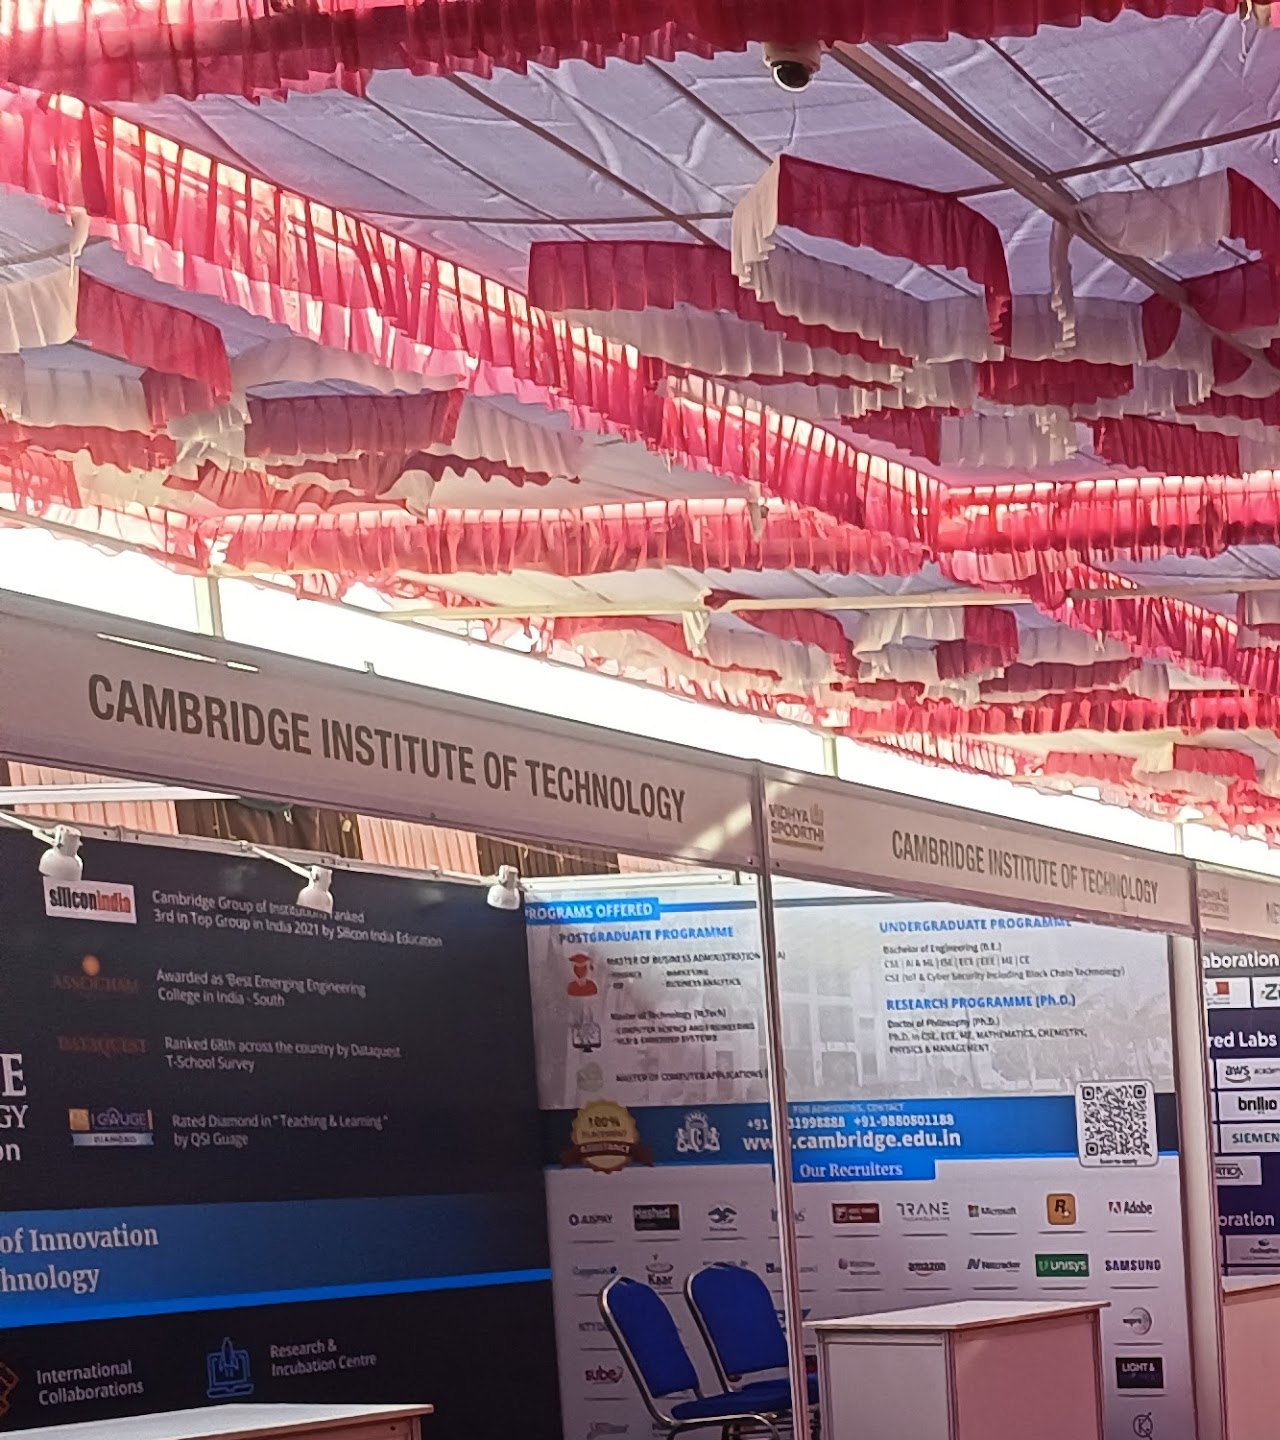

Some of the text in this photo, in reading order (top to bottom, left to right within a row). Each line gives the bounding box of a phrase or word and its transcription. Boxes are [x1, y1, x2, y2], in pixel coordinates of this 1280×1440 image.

[88, 674, 686, 824] CAMBRIDGE INSTITUTE OF TECHNOLOGY
[768, 803, 809, 824] VIDHYA
[770, 819, 824, 843] SPOORTHI
[891, 829, 985, 873] CAMBRIDGE
[988, 848, 1058, 888] INSTITUTE
[1061, 862, 1078, 891] OF
[1080, 866, 1159, 905] TECHNOLOGY
[152, 890, 267, 914] Cambridge Group of
[595, 902, 653, 919] OFFERED
[153, 909, 174, 923] 3rd
[177, 911, 188, 924] in
[191, 912, 213, 928] Top
[215, 914, 251, 930] Group
[253, 918, 263, 929] in
[266, 919, 292, 934] India
[294, 921, 319, 936] 2021
[322, 924, 335, 940] by
[879, 919, 987, 933] UNDERGRADUATE
[558, 926, 735, 945] POSTGRADUATE PROGRAMME
[156, 968, 208, 986] Awarded
[210, 974, 224, 986] as
[306, 978, 367, 999] Engineering
[158, 988, 285, 1007] College in India South
[886, 998, 949, 1011] RESEARCH
[951, 996, 1033, 1008] PROGRAMME
[165, 1036, 208, 1050] Ranked
[238, 1041, 273, 1053] across
[275, 1040, 293, 1054] the
[295, 1042, 334, 1058] country
[337, 1043, 349, 1058] by
[1239, 1030, 1278, 1048] Labs
[218, 1056, 255, 1073] Survey
[172, 1114, 205, 1128] Rated
[261, 1115, 272, 1128] in
[173, 1133, 188, 1149] by
[742, 1128, 962, 1152] ww.cambridge.edu.in
[800, 1161, 904, 1178] Our Recruiters
[1123, 1201, 1153, 1214] Adobe
[0, 1222, 159, 1254] of Innovation
[1105, 1259, 1161, 1272] SAMSUNG
[270, 1338, 337, 1360] Research &
[36, 1359, 133, 1387] International
[271, 1353, 377, 1378] Incubation Centre
[38, 1379, 145, 1407] Collaborations
